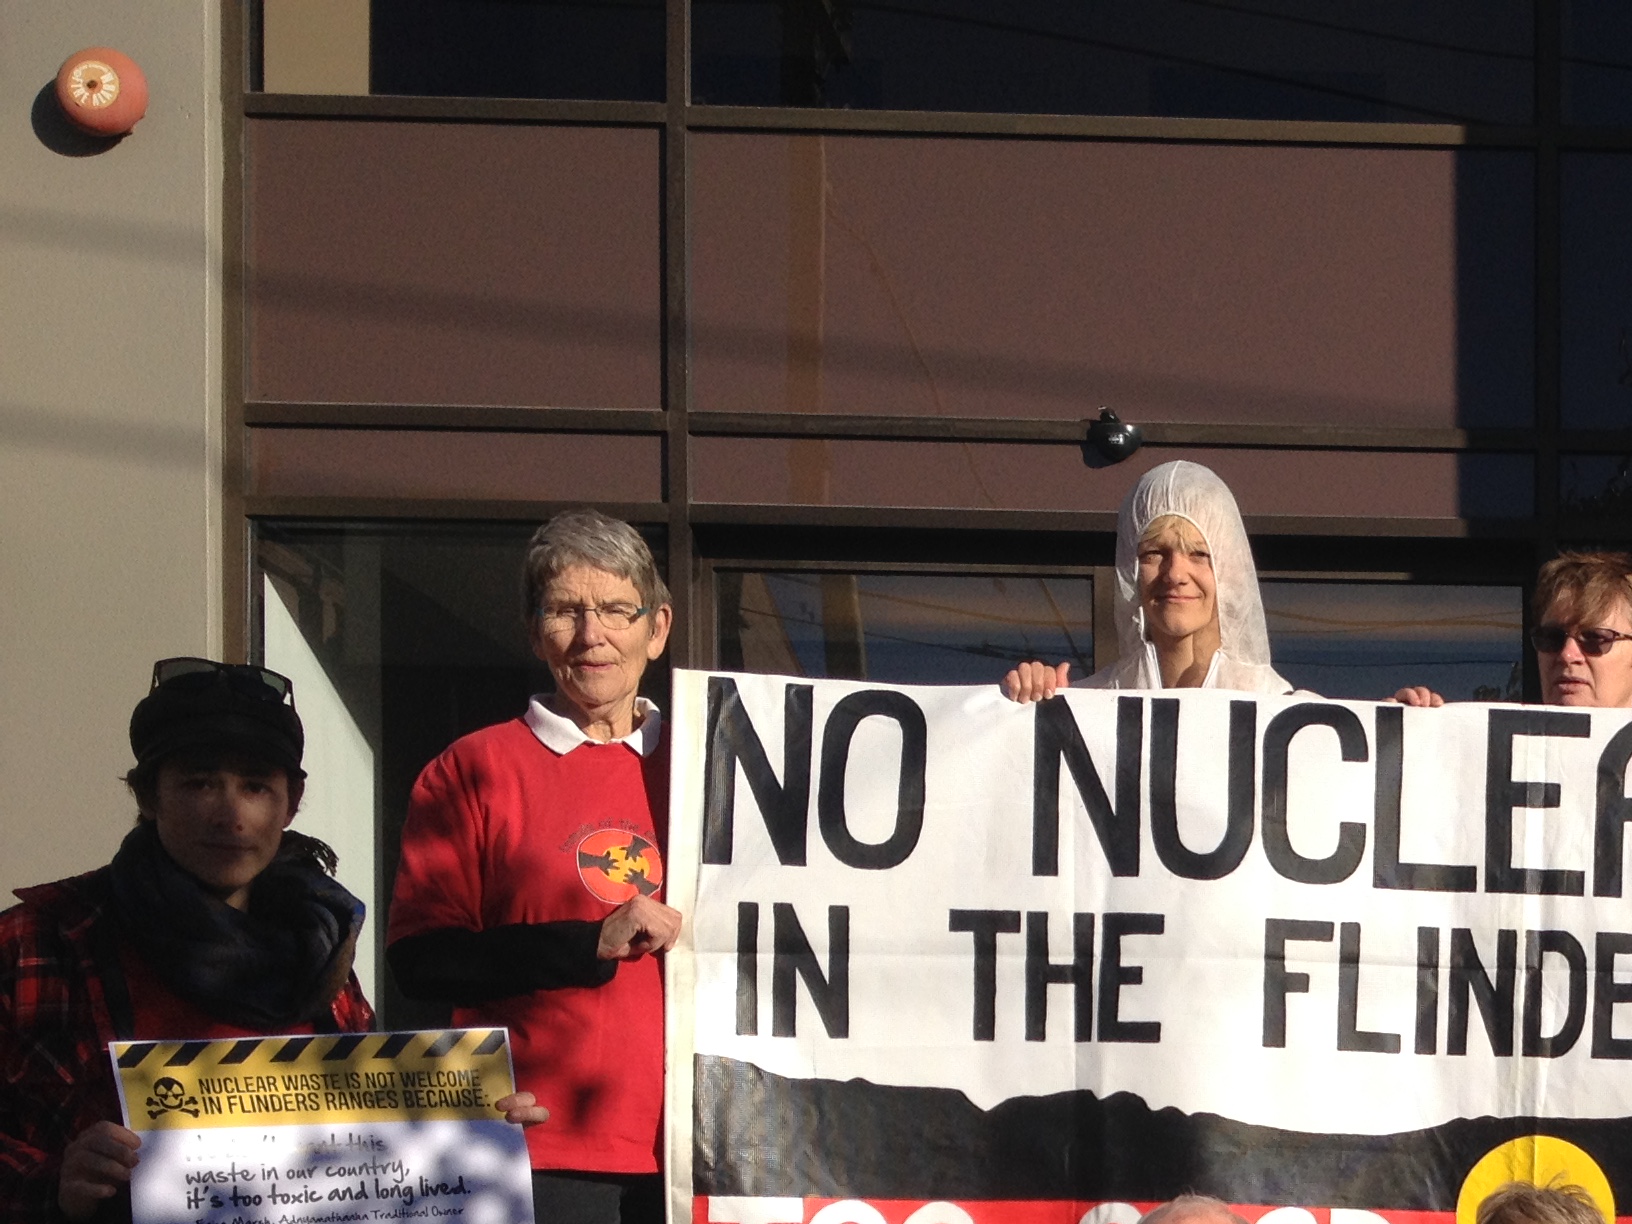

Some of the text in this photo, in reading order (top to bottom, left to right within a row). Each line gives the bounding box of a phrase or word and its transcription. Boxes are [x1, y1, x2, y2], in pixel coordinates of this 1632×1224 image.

[701, 677, 927, 870] NO
[735, 900, 850, 1041] IN
[949, 908, 1166, 1045] THE
[198, 1069, 482, 1096] NUCLEAR WASTE IS NOT WELCOME
[202, 1088, 491, 1115] IN FLINDERS RANGES BECAUSE:
[186, 1156, 411, 1186] waste in our country,
[186, 1176, 472, 1210] it's too toxic and long lived.
[370, 1205, 429, 1221] Traditional
[431, 1206, 465, 1217] Owner
